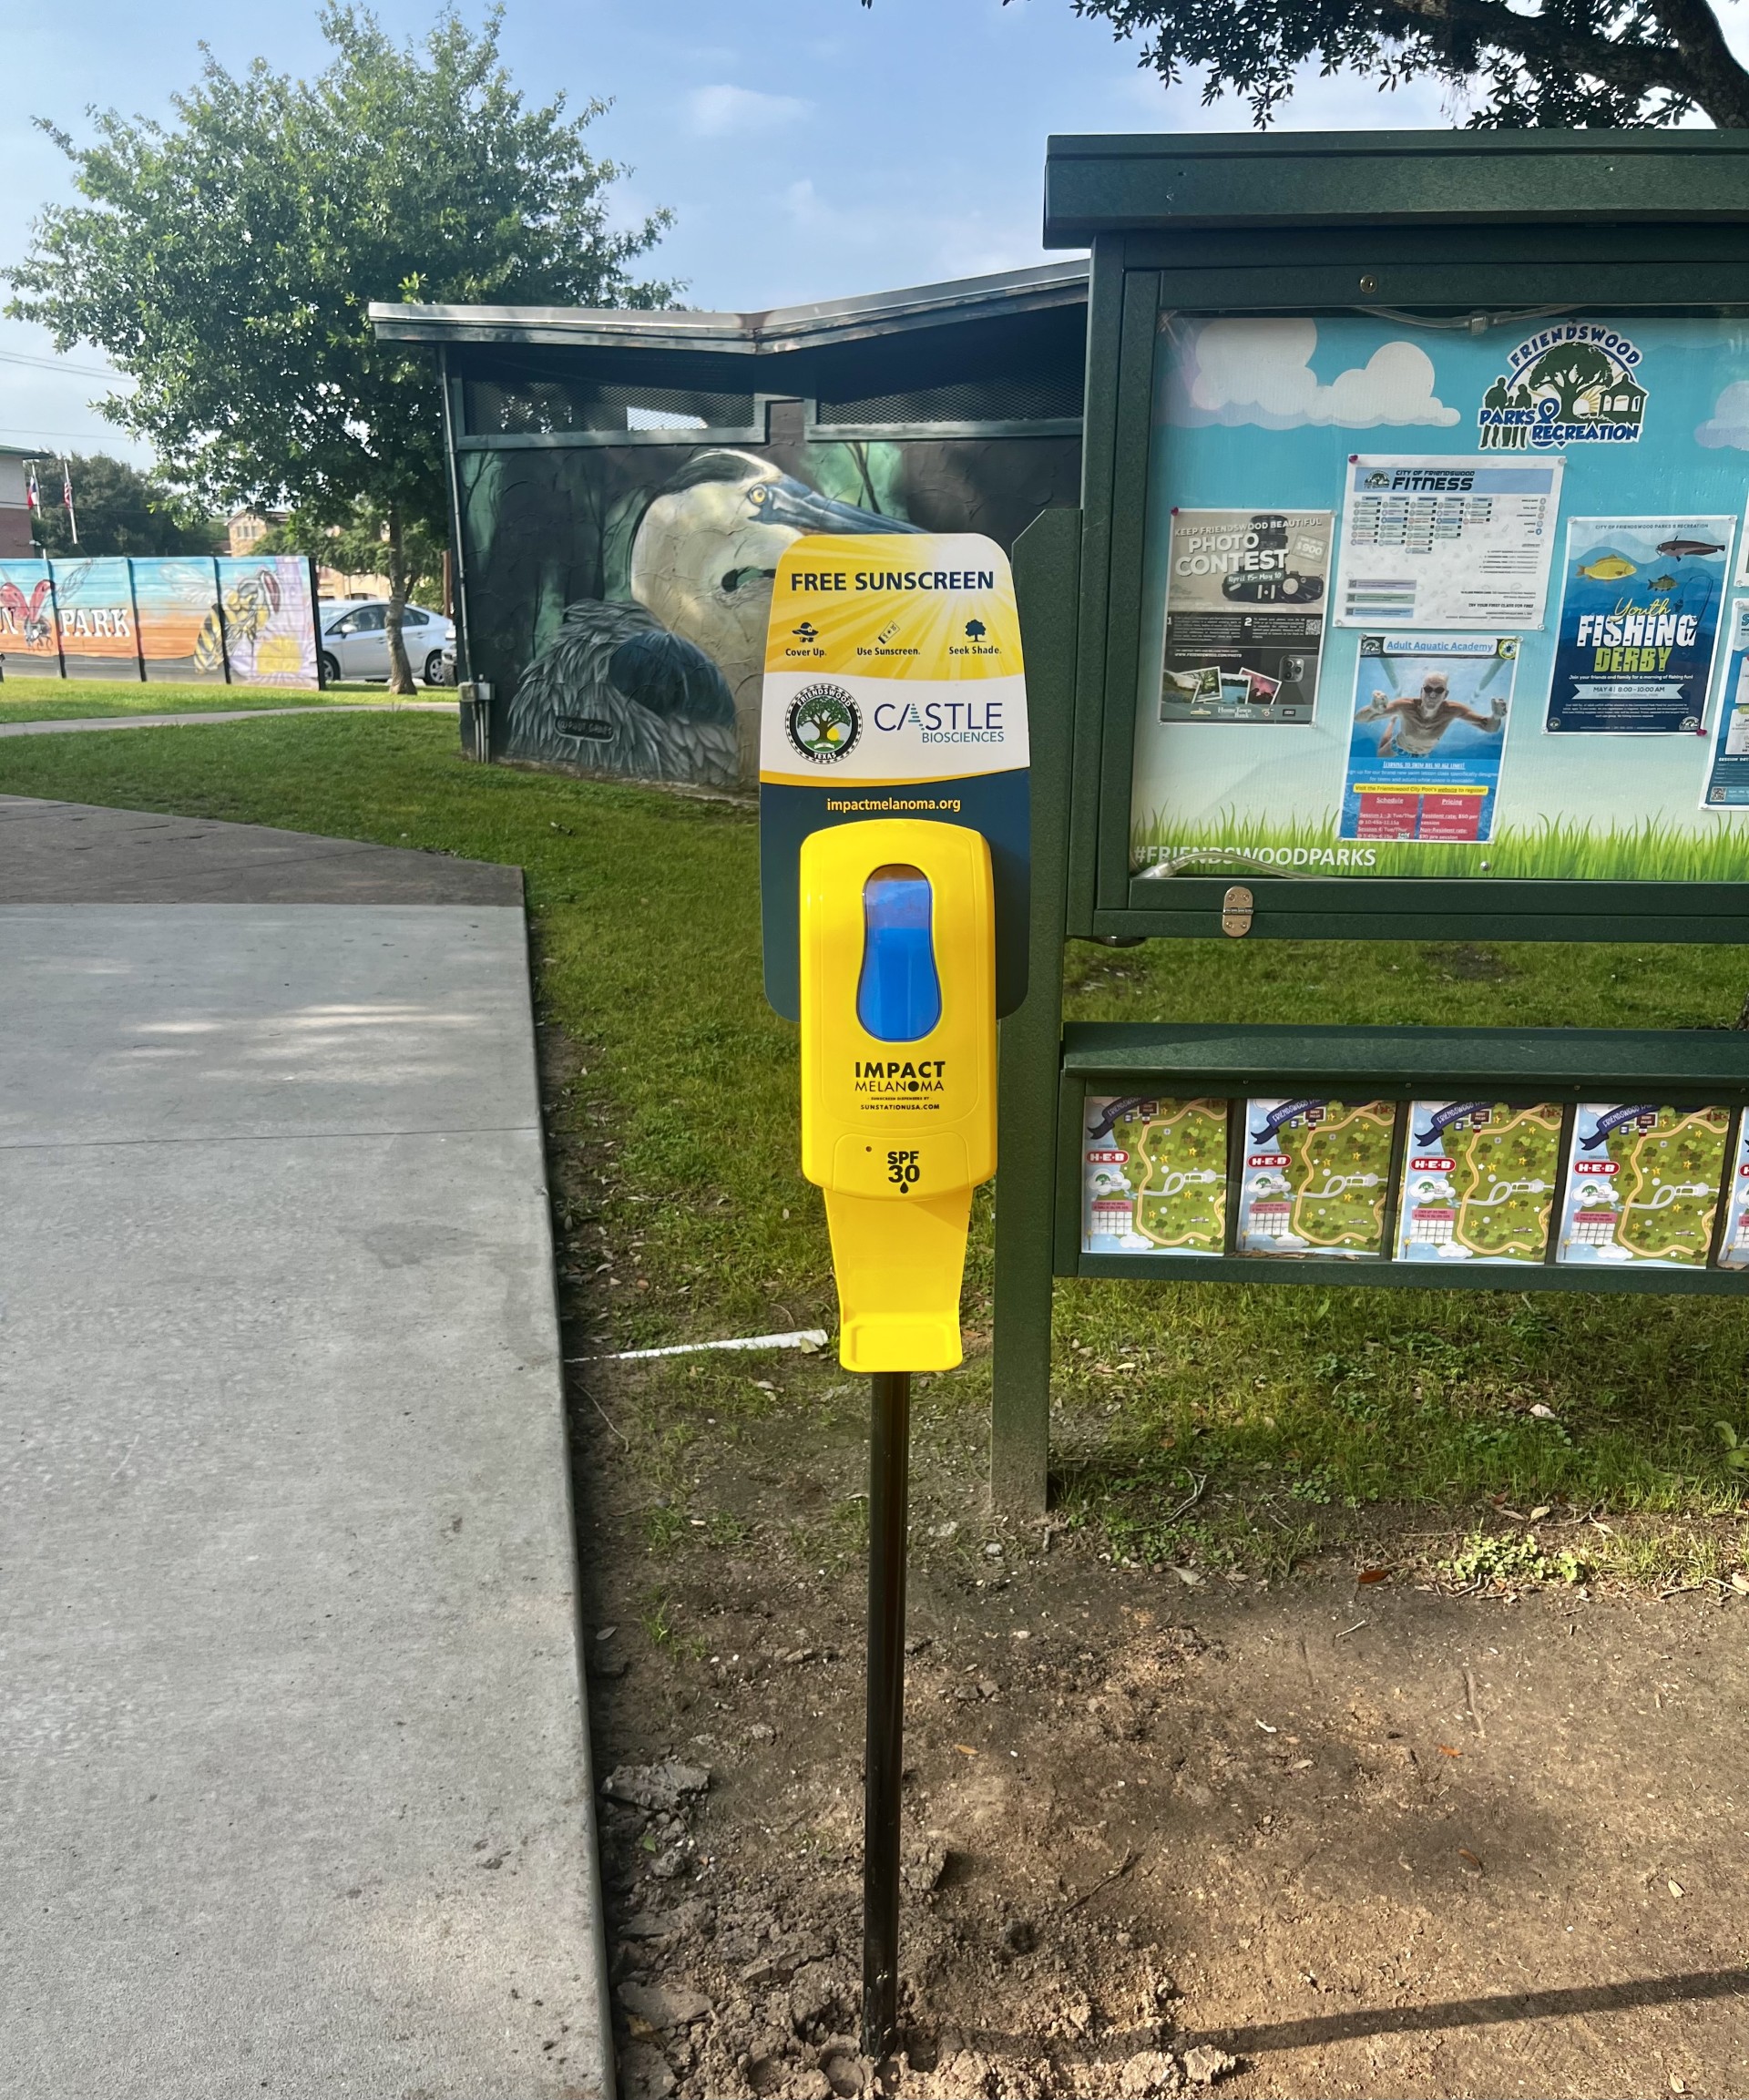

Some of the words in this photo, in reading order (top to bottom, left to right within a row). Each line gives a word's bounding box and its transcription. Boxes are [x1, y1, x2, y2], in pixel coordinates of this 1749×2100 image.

[1509, 325, 1640, 367] FRIENDSWOOD
[1479, 409, 1536, 425] PARKS
[1531, 425, 1640, 441] RECREATION
[1392, 477, 1474, 490] FITNESS
[1175, 528, 1198, 537] KEEP
[1201, 522, 1268, 536] FRIENDSWOOD
[1270, 517, 1323, 528] BEAUTIFUL
[1189, 533, 1260, 554] PHOTO
[1175, 548, 1290, 577] CONTEST
[791, 572, 846, 591] FREE
[854, 570, 994, 591] SUNSCREEN
[1609, 597, 1672, 622] Youth
[60, 609, 130, 637] PARK
[1243, 617, 1253, 626] 2
[1577, 614, 1698, 647] FISHING
[785, 648, 809, 657] Cover
[813, 648, 827, 658] Up.
[857, 647, 873, 656] Use
[874, 647, 921, 656] Sunscreen.
[949, 646, 969, 655] Seek
[972, 646, 1002, 655] Shade.
[1386, 641, 1411, 650] Adult
[1414, 641, 1449, 651] Aquatic
[1450, 642, 1493, 652] Academy
[1594, 647, 1672, 672] DERBY
[796, 688, 852, 707] FRIENDSWOOD
[874, 702, 1003, 732] CASTLE
[921, 732, 1004, 743] BIOSCIENCES
[813, 752, 837, 760] TEXAS
[826, 797, 961, 812] impactmelanoma.org
[1134, 845, 1376, 866] #FRIENDSWOODPARKS
[854, 1061, 946, 1079] IMPACT
[854, 1080, 945, 1092] MELANOMA
[887, 1151, 920, 1165] SPF
[888, 1164, 920, 1183] 30
